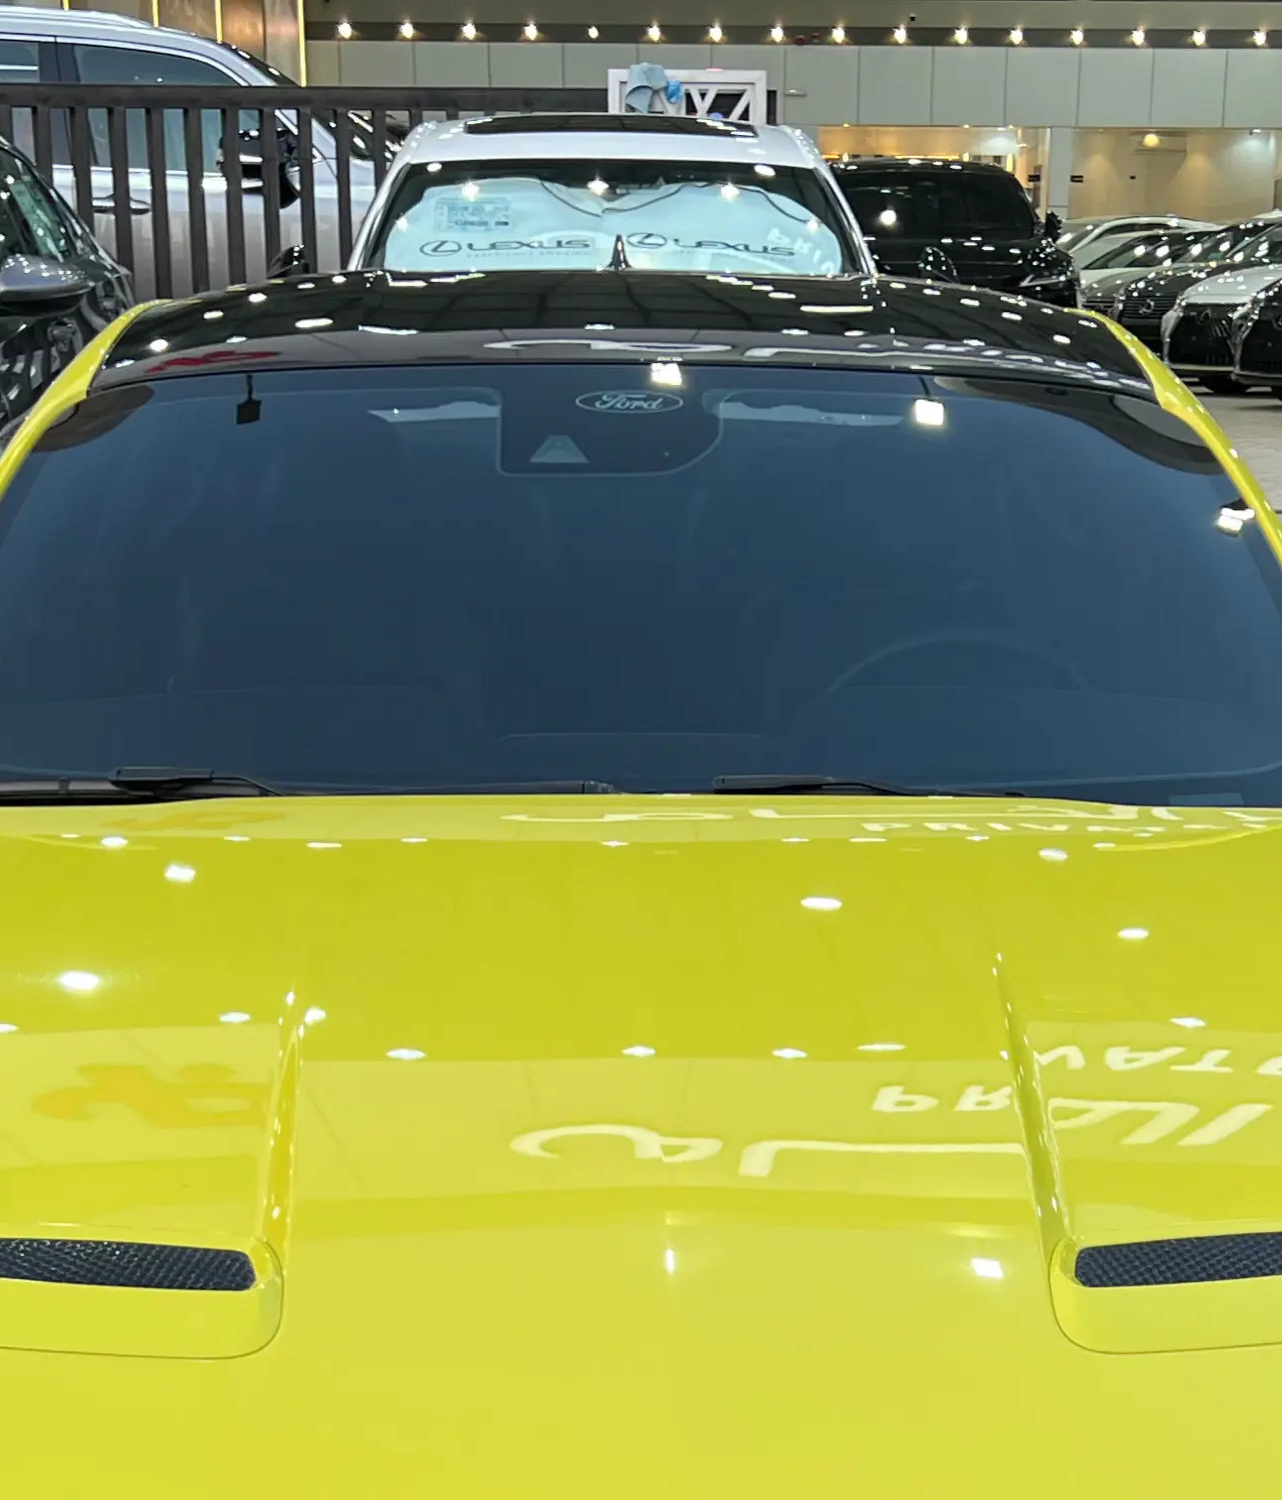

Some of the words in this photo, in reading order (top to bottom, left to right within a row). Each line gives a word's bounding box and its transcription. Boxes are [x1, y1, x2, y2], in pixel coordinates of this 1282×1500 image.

[466, 238, 592, 252] LEXUS
[673, 237, 796, 257] LEXUS
[594, 393, 665, 410] Ford
